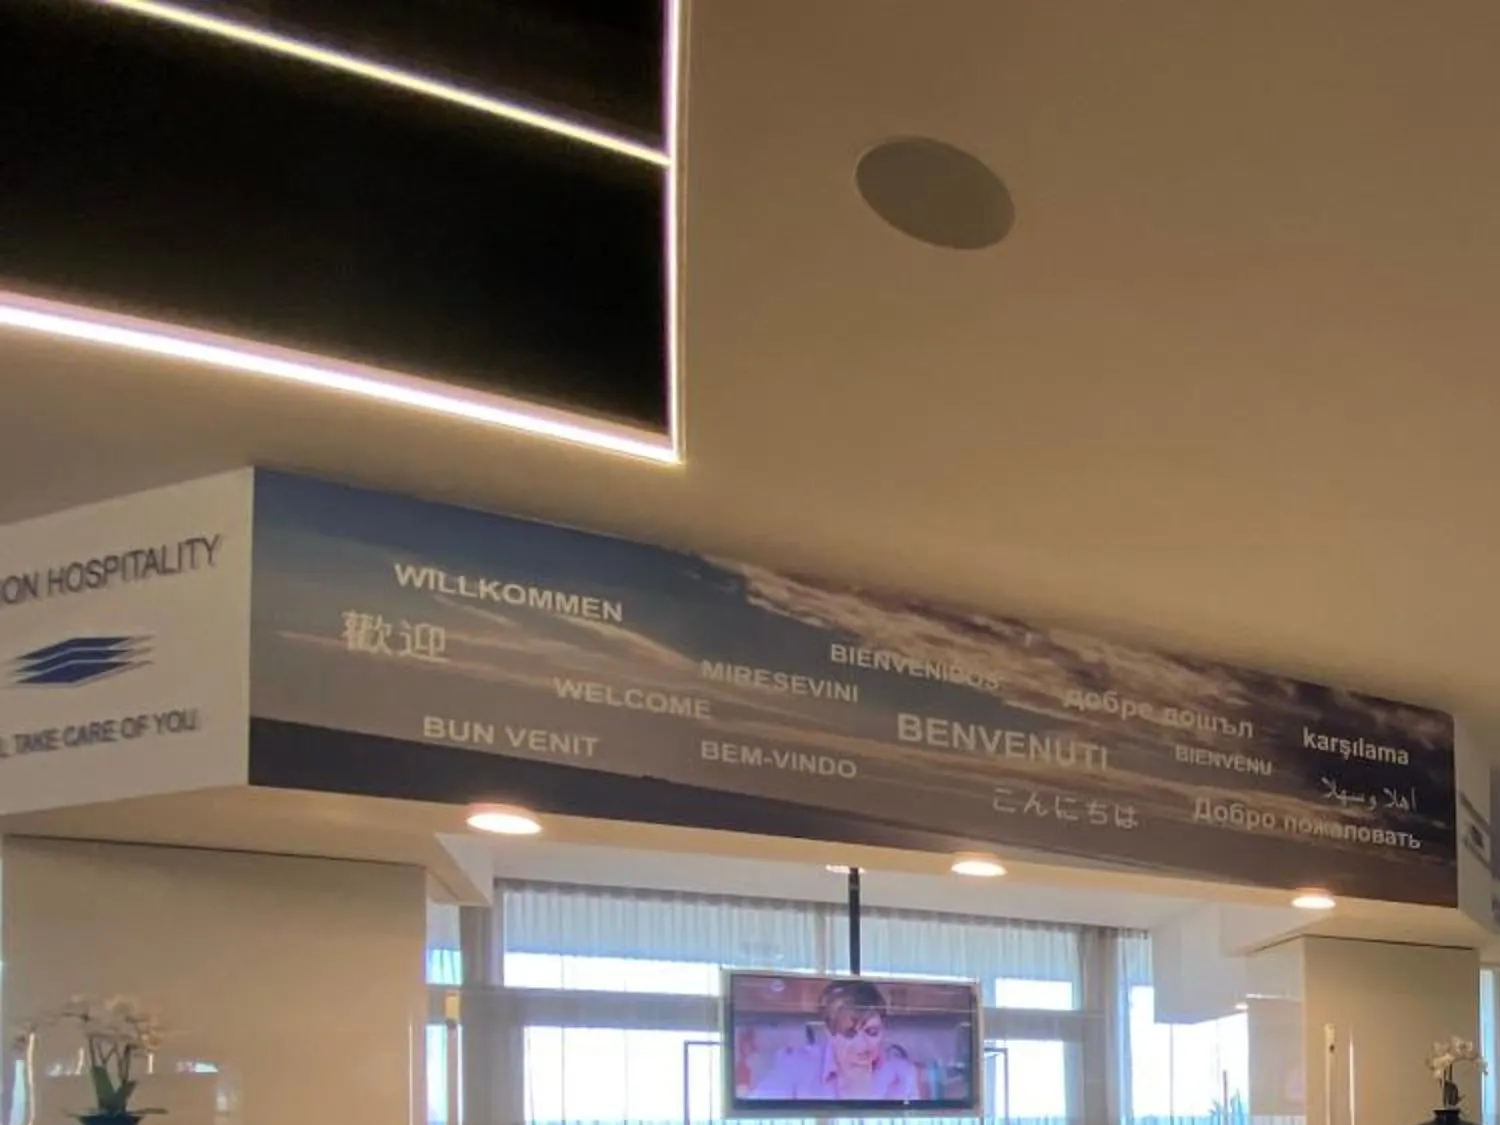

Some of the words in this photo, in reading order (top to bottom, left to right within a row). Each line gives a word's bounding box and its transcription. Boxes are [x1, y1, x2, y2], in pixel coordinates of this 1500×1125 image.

[0, 571, 40, 604] ON
[48, 534, 221, 596] HOSPITALITY
[394, 562, 623, 624] WILLKOMMEN
[340, 609, 450, 662] 歡迎
[702, 659, 859, 703] MIRESEVINI
[831, 644, 1000, 691] BIENVENIDOS
[553, 676, 712, 721] WELCOME
[1063, 690, 1153, 720] добре
[1163, 706, 1254, 739] дошъл
[63, 720, 116, 748] CARE
[120, 714, 150, 738] OF
[154, 708, 198, 736] YOU
[423, 715, 495, 747] BUN
[505, 725, 600, 758] VENIT
[897, 713, 1108, 771] BENVENUTI
[1303, 727, 1410, 767] karşılama
[701, 739, 858, 779] BEM-VINDO
[1175, 744, 1273, 777] BIENVENU
[992, 787, 1139, 830] こんにちは
[1193, 796, 1276, 831] Добро
[1284, 815, 1422, 850] пожаловать
